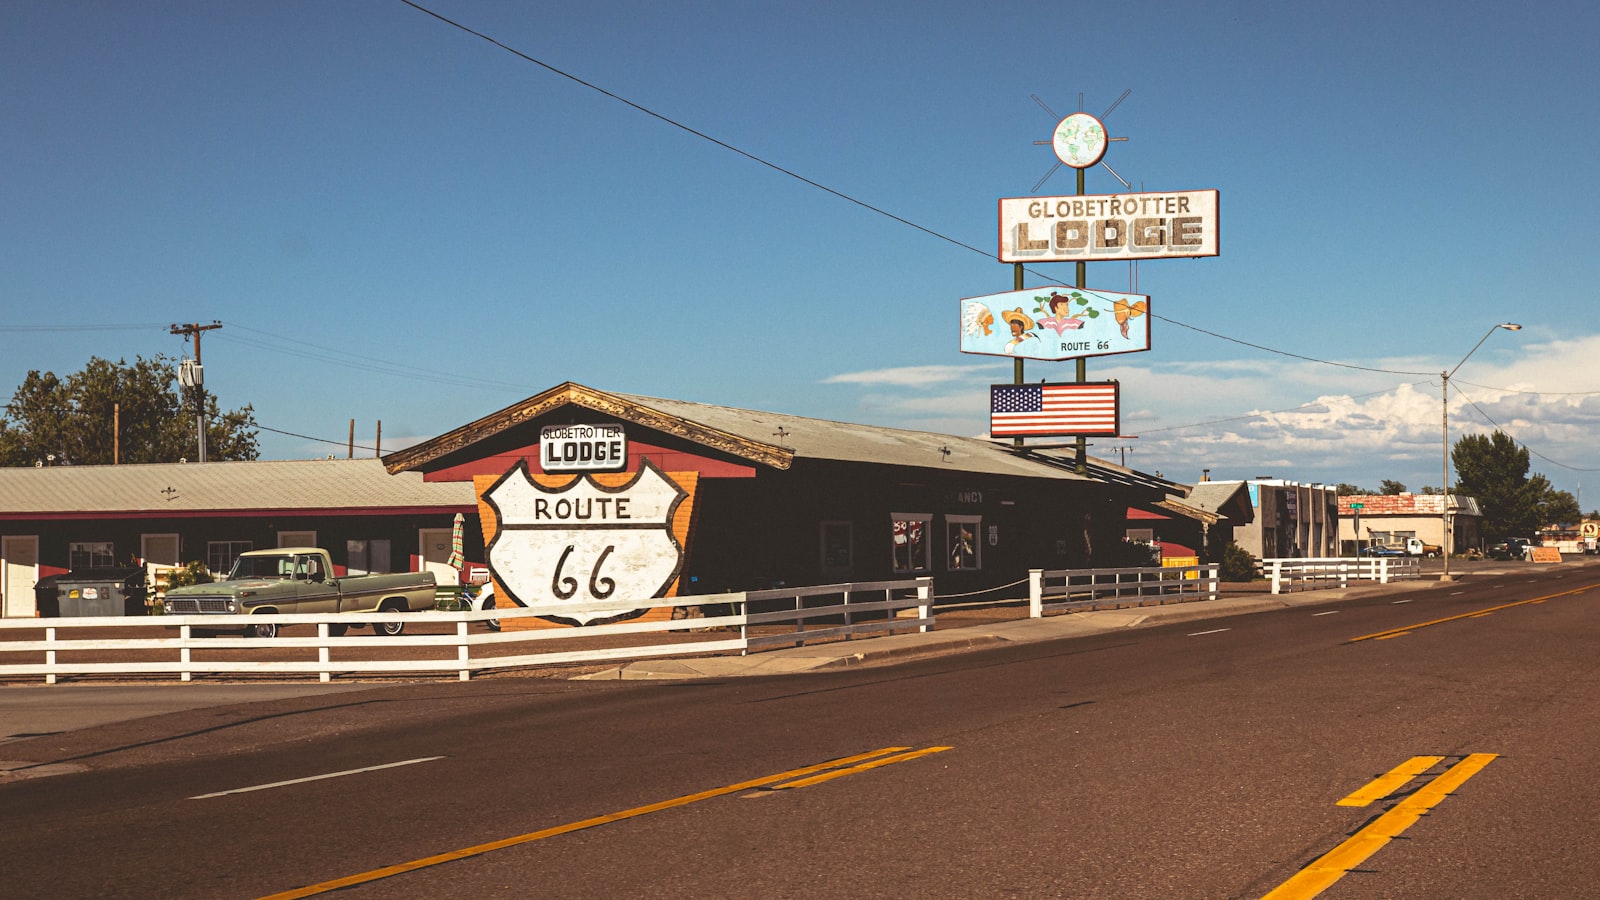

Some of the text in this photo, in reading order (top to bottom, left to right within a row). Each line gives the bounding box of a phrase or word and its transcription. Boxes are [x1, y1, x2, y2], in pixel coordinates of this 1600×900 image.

[1028, 196, 1190, 219] GLOBETROTTER
[1016, 217, 1203, 252] LODGE
[1061, 342, 1091, 352] ROUTE
[543, 426, 621, 439] GLOBETROTTER
[547, 441, 621, 463] LODGE
[534, 497, 632, 520] ROUTE
[551, 544, 616, 600] 66
